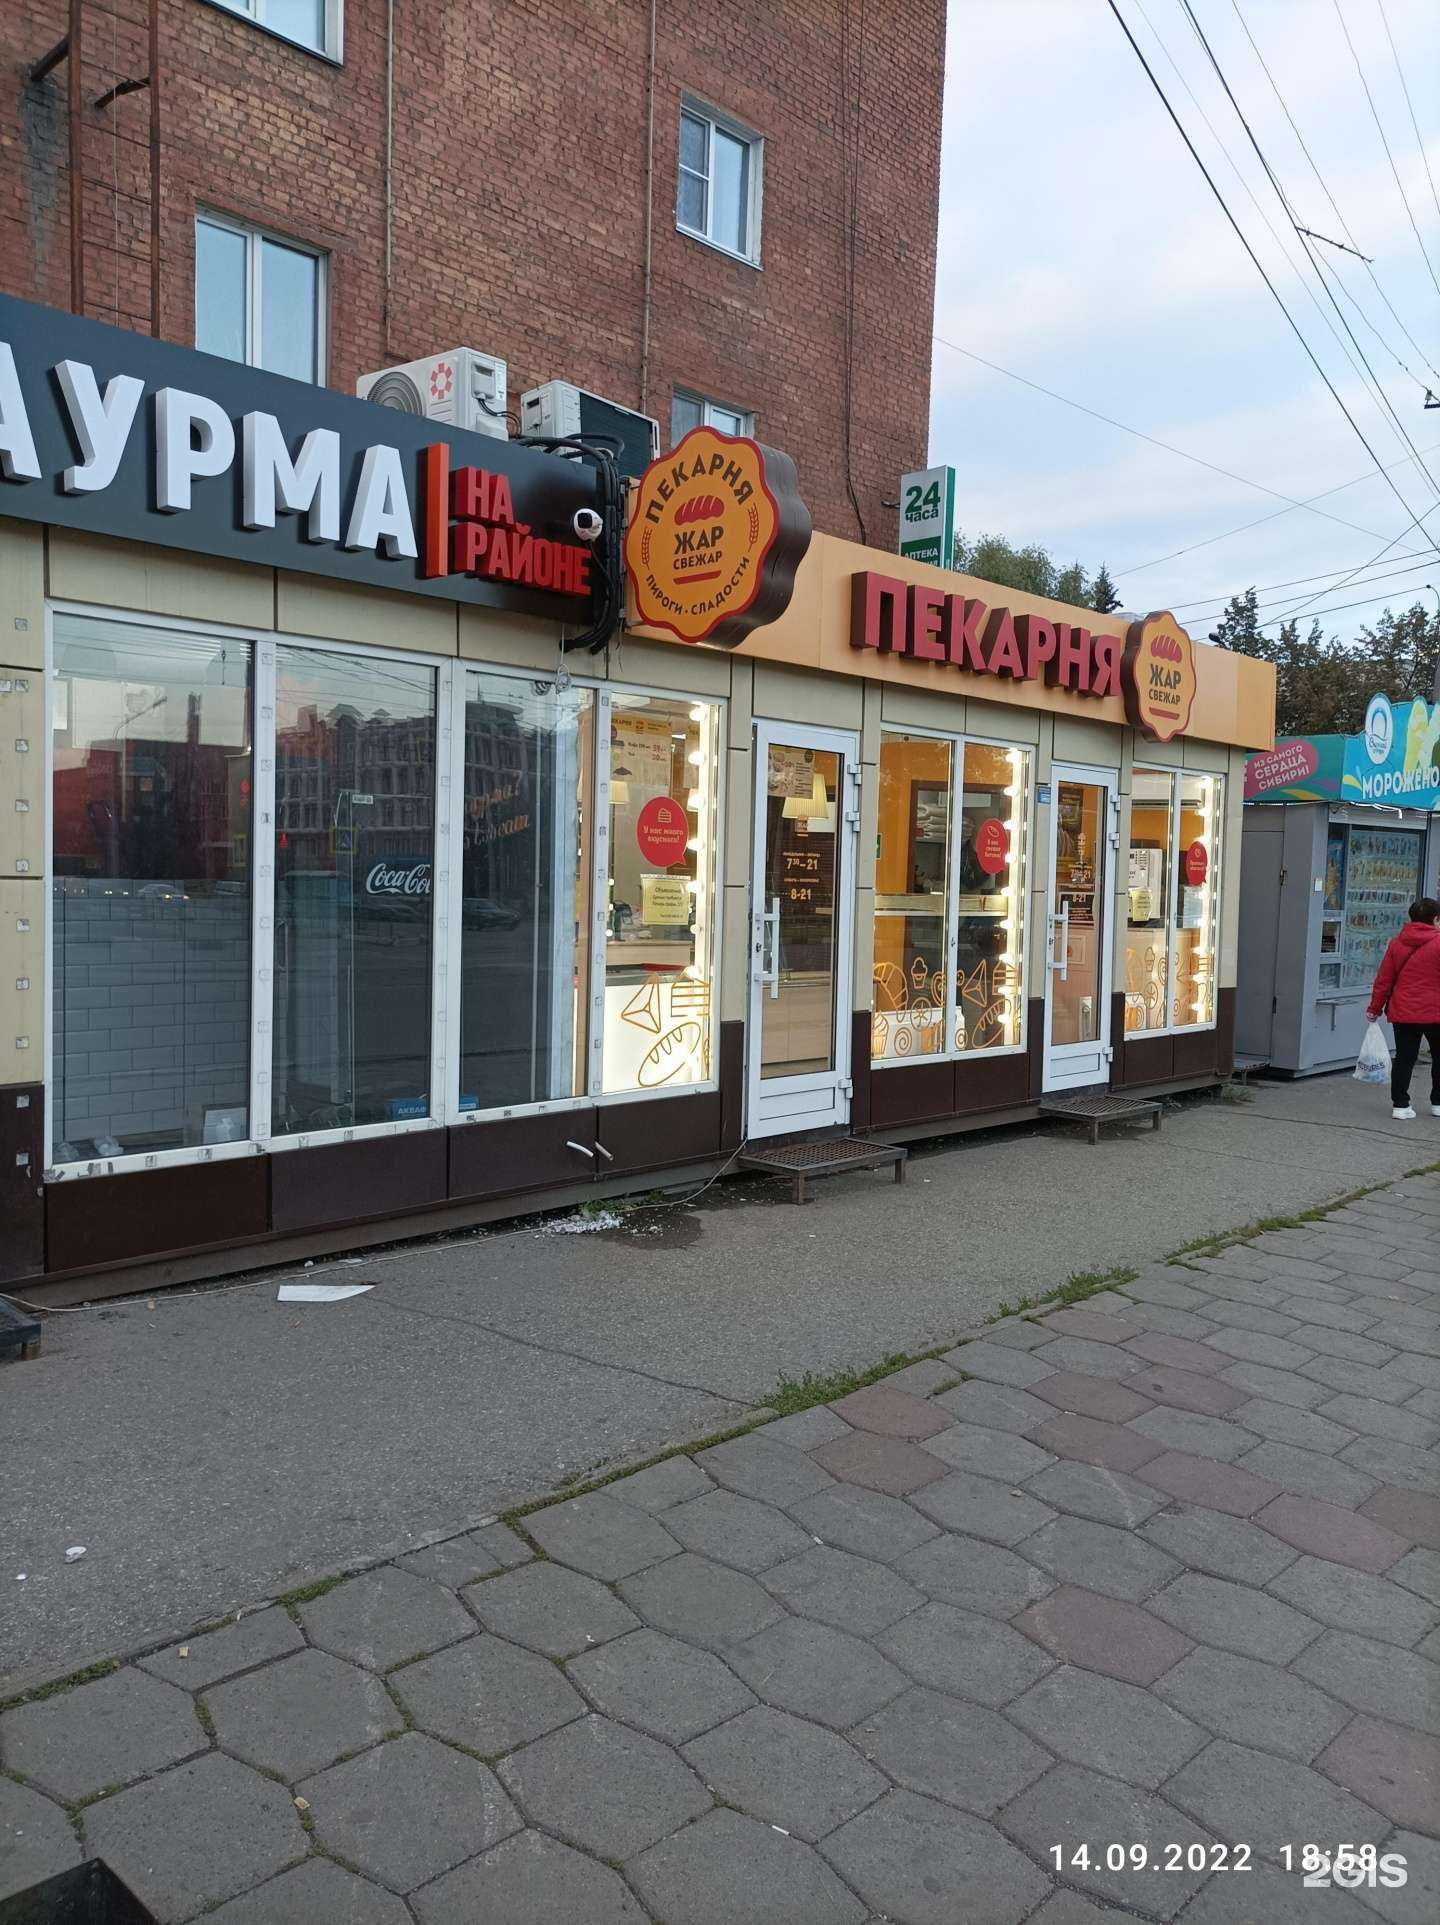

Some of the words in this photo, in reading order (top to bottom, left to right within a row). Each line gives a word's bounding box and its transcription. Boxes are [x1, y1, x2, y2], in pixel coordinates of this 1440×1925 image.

[450, 466, 515, 520] НА
[645, 453, 754, 524] ПЕКАРНЯ
[905, 480, 941, 513] 24
[905, 506, 939, 523] часа
[673, 525, 725, 555] ЖАР
[452, 522, 593, 597] РАЙОНЕ
[673, 550, 723, 571] СВЕЖАР
[645, 574, 683, 615] ПИРОГИ
[691, 556, 750, 616] СЛАДОСТИ
[850, 571, 1121, 698] ПЕКАРНЯ
[1149, 663, 1182, 690] ЖАР
[1149, 688, 1181, 705] СВЕЖАР
[1254, 759, 1265, 769] ИЗ
[1266, 745, 1303, 764] САМОГО
[1255, 753, 1307, 779] СЕРДЦА
[1259, 765, 1310, 790] СИБИРИ!
